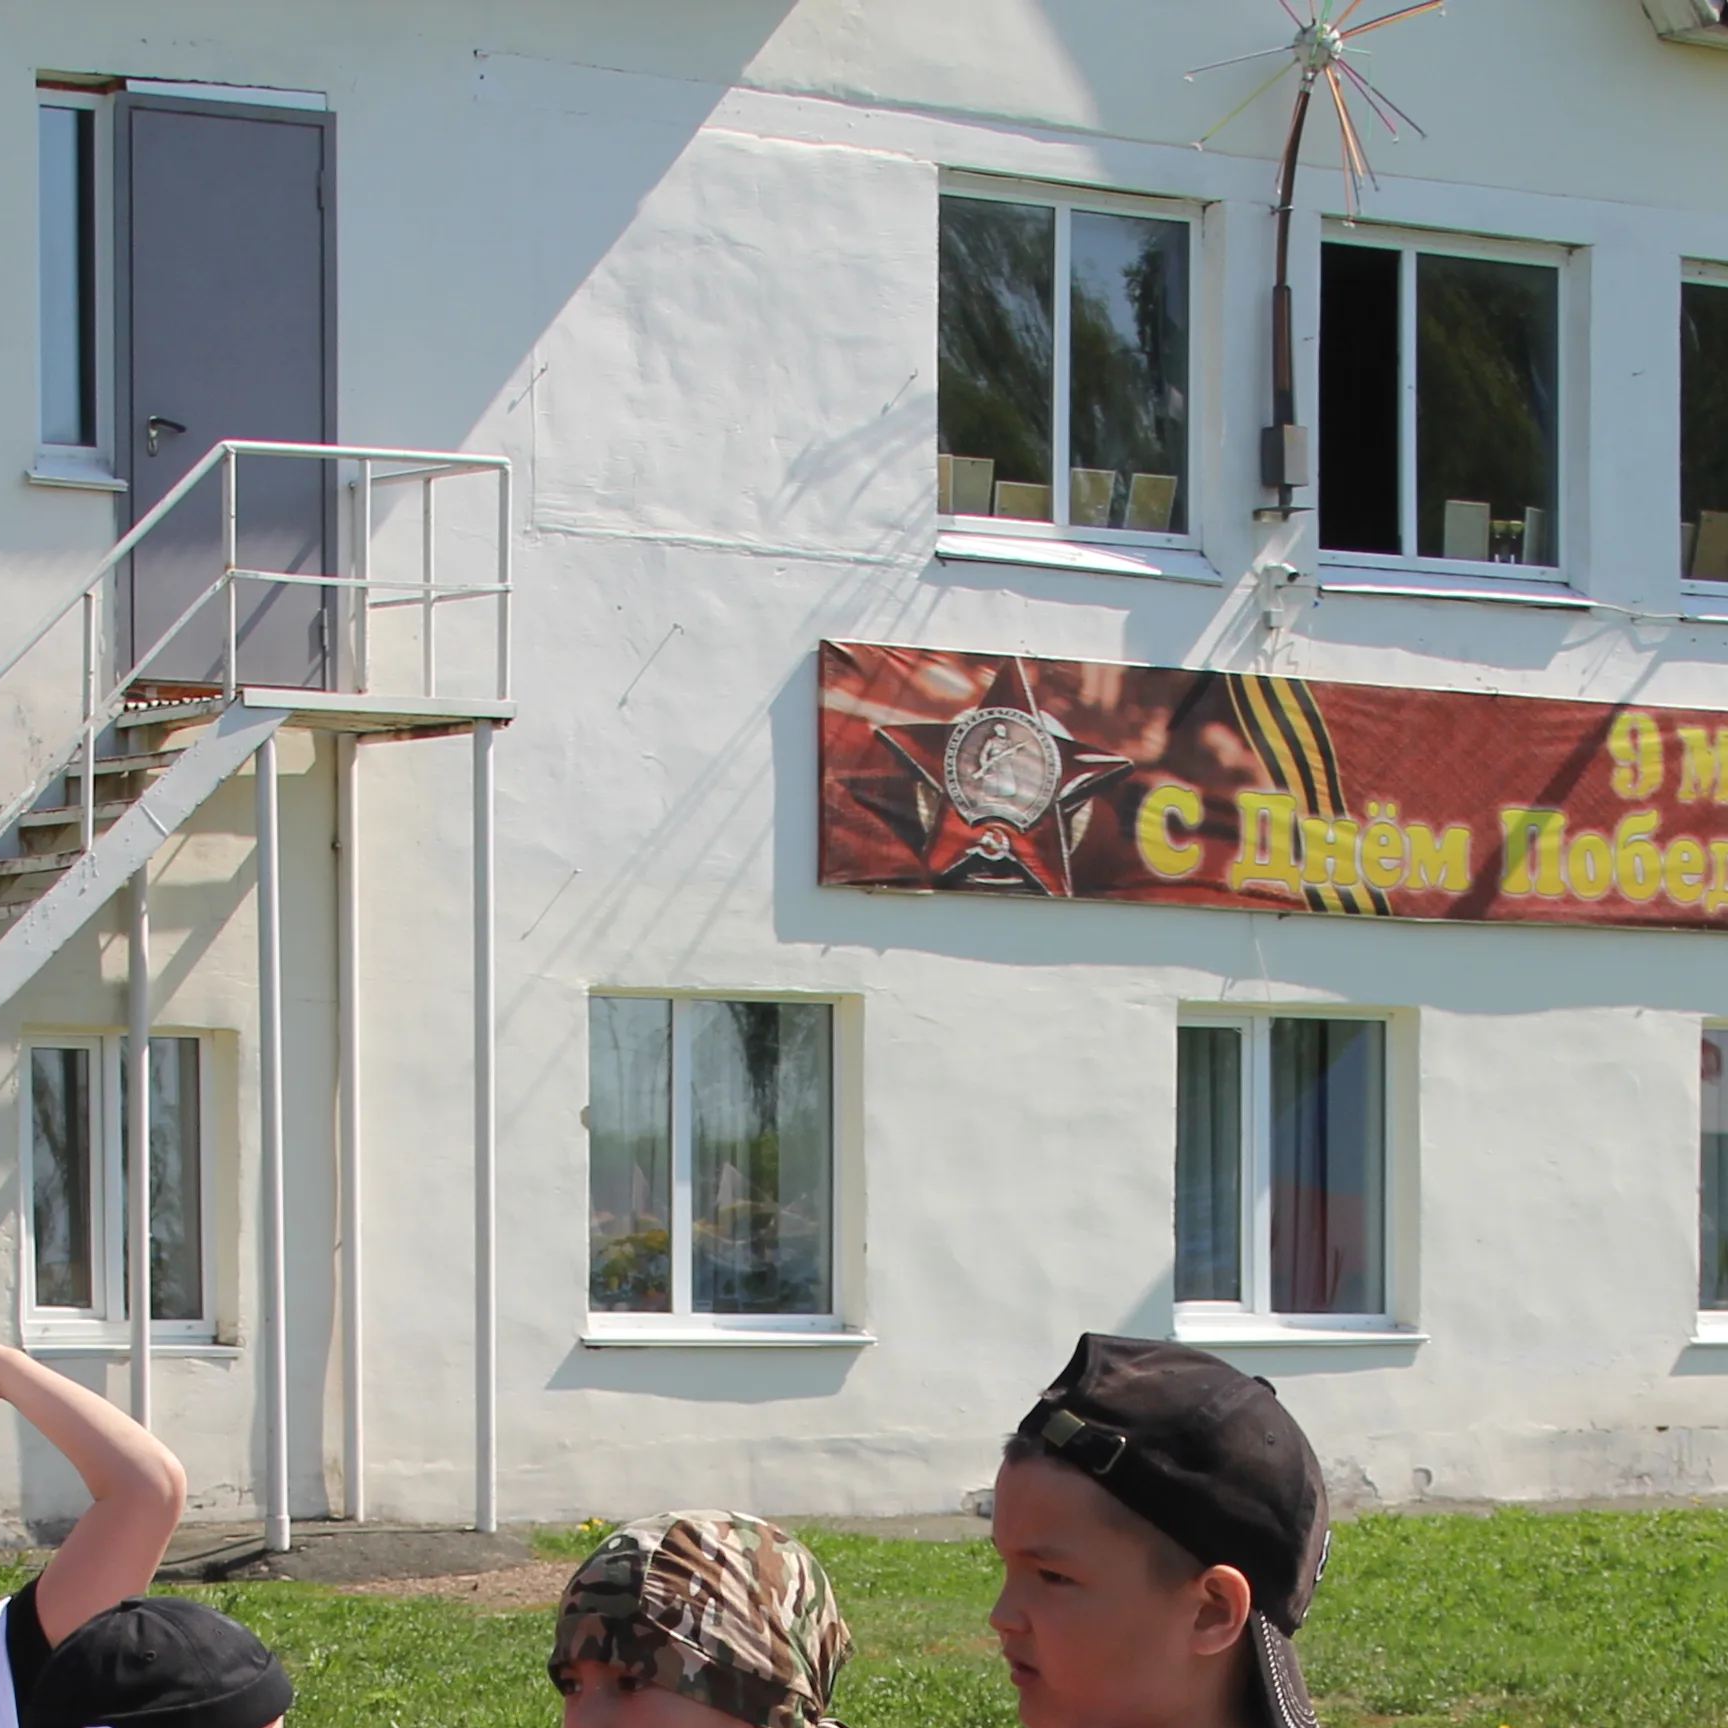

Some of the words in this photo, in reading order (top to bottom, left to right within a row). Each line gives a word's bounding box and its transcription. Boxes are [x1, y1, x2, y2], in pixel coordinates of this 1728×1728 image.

[1608, 711, 1664, 799] 9
[1137, 783, 1204, 878] С
[1229, 790, 1471, 894] Днём
